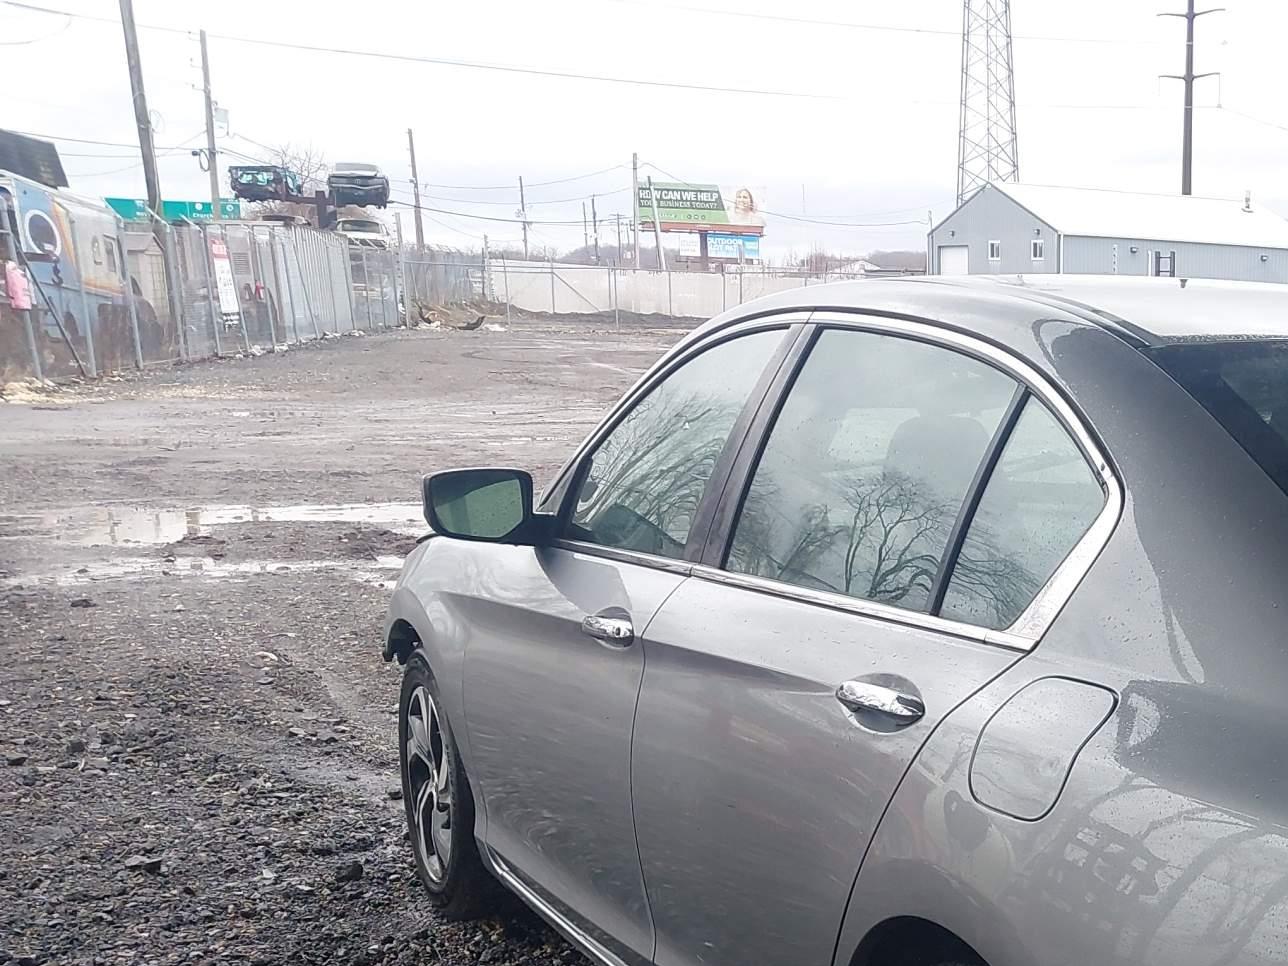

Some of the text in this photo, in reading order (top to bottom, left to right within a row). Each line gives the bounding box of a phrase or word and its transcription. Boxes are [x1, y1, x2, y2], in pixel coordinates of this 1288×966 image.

[662, 190, 681, 201] CAN
[682, 191, 697, 201] WE
[697, 192, 719, 202] HELP
